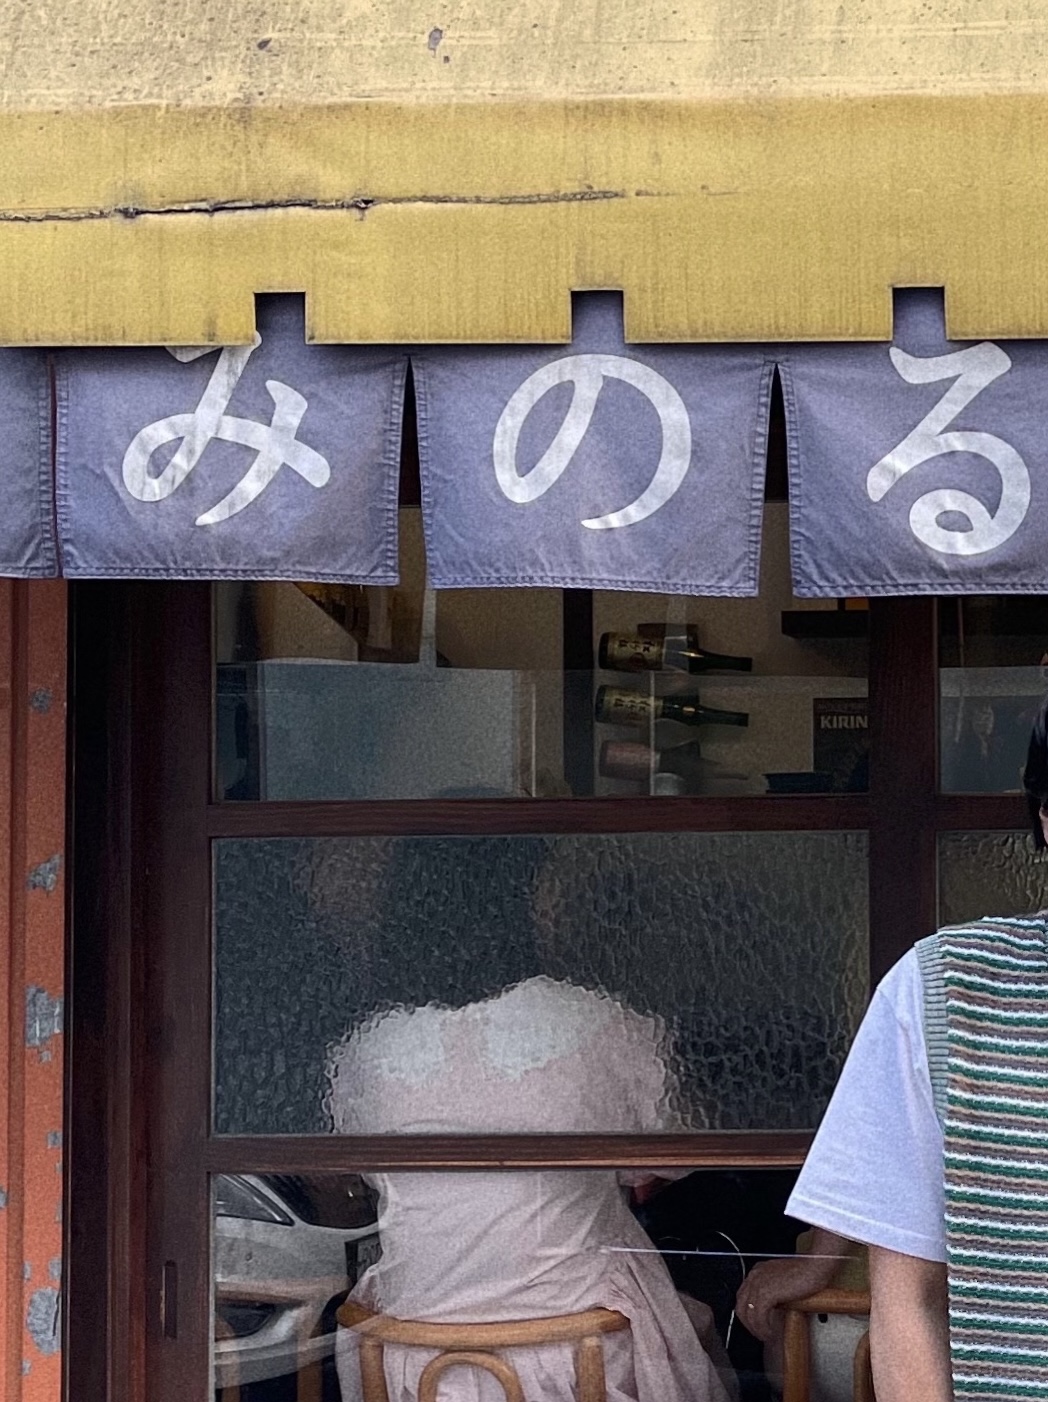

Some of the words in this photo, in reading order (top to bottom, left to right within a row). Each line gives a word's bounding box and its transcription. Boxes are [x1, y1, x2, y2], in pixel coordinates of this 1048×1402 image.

[121, 331, 1031, 556] みのる
[820, 714, 869, 729] KIRIN
